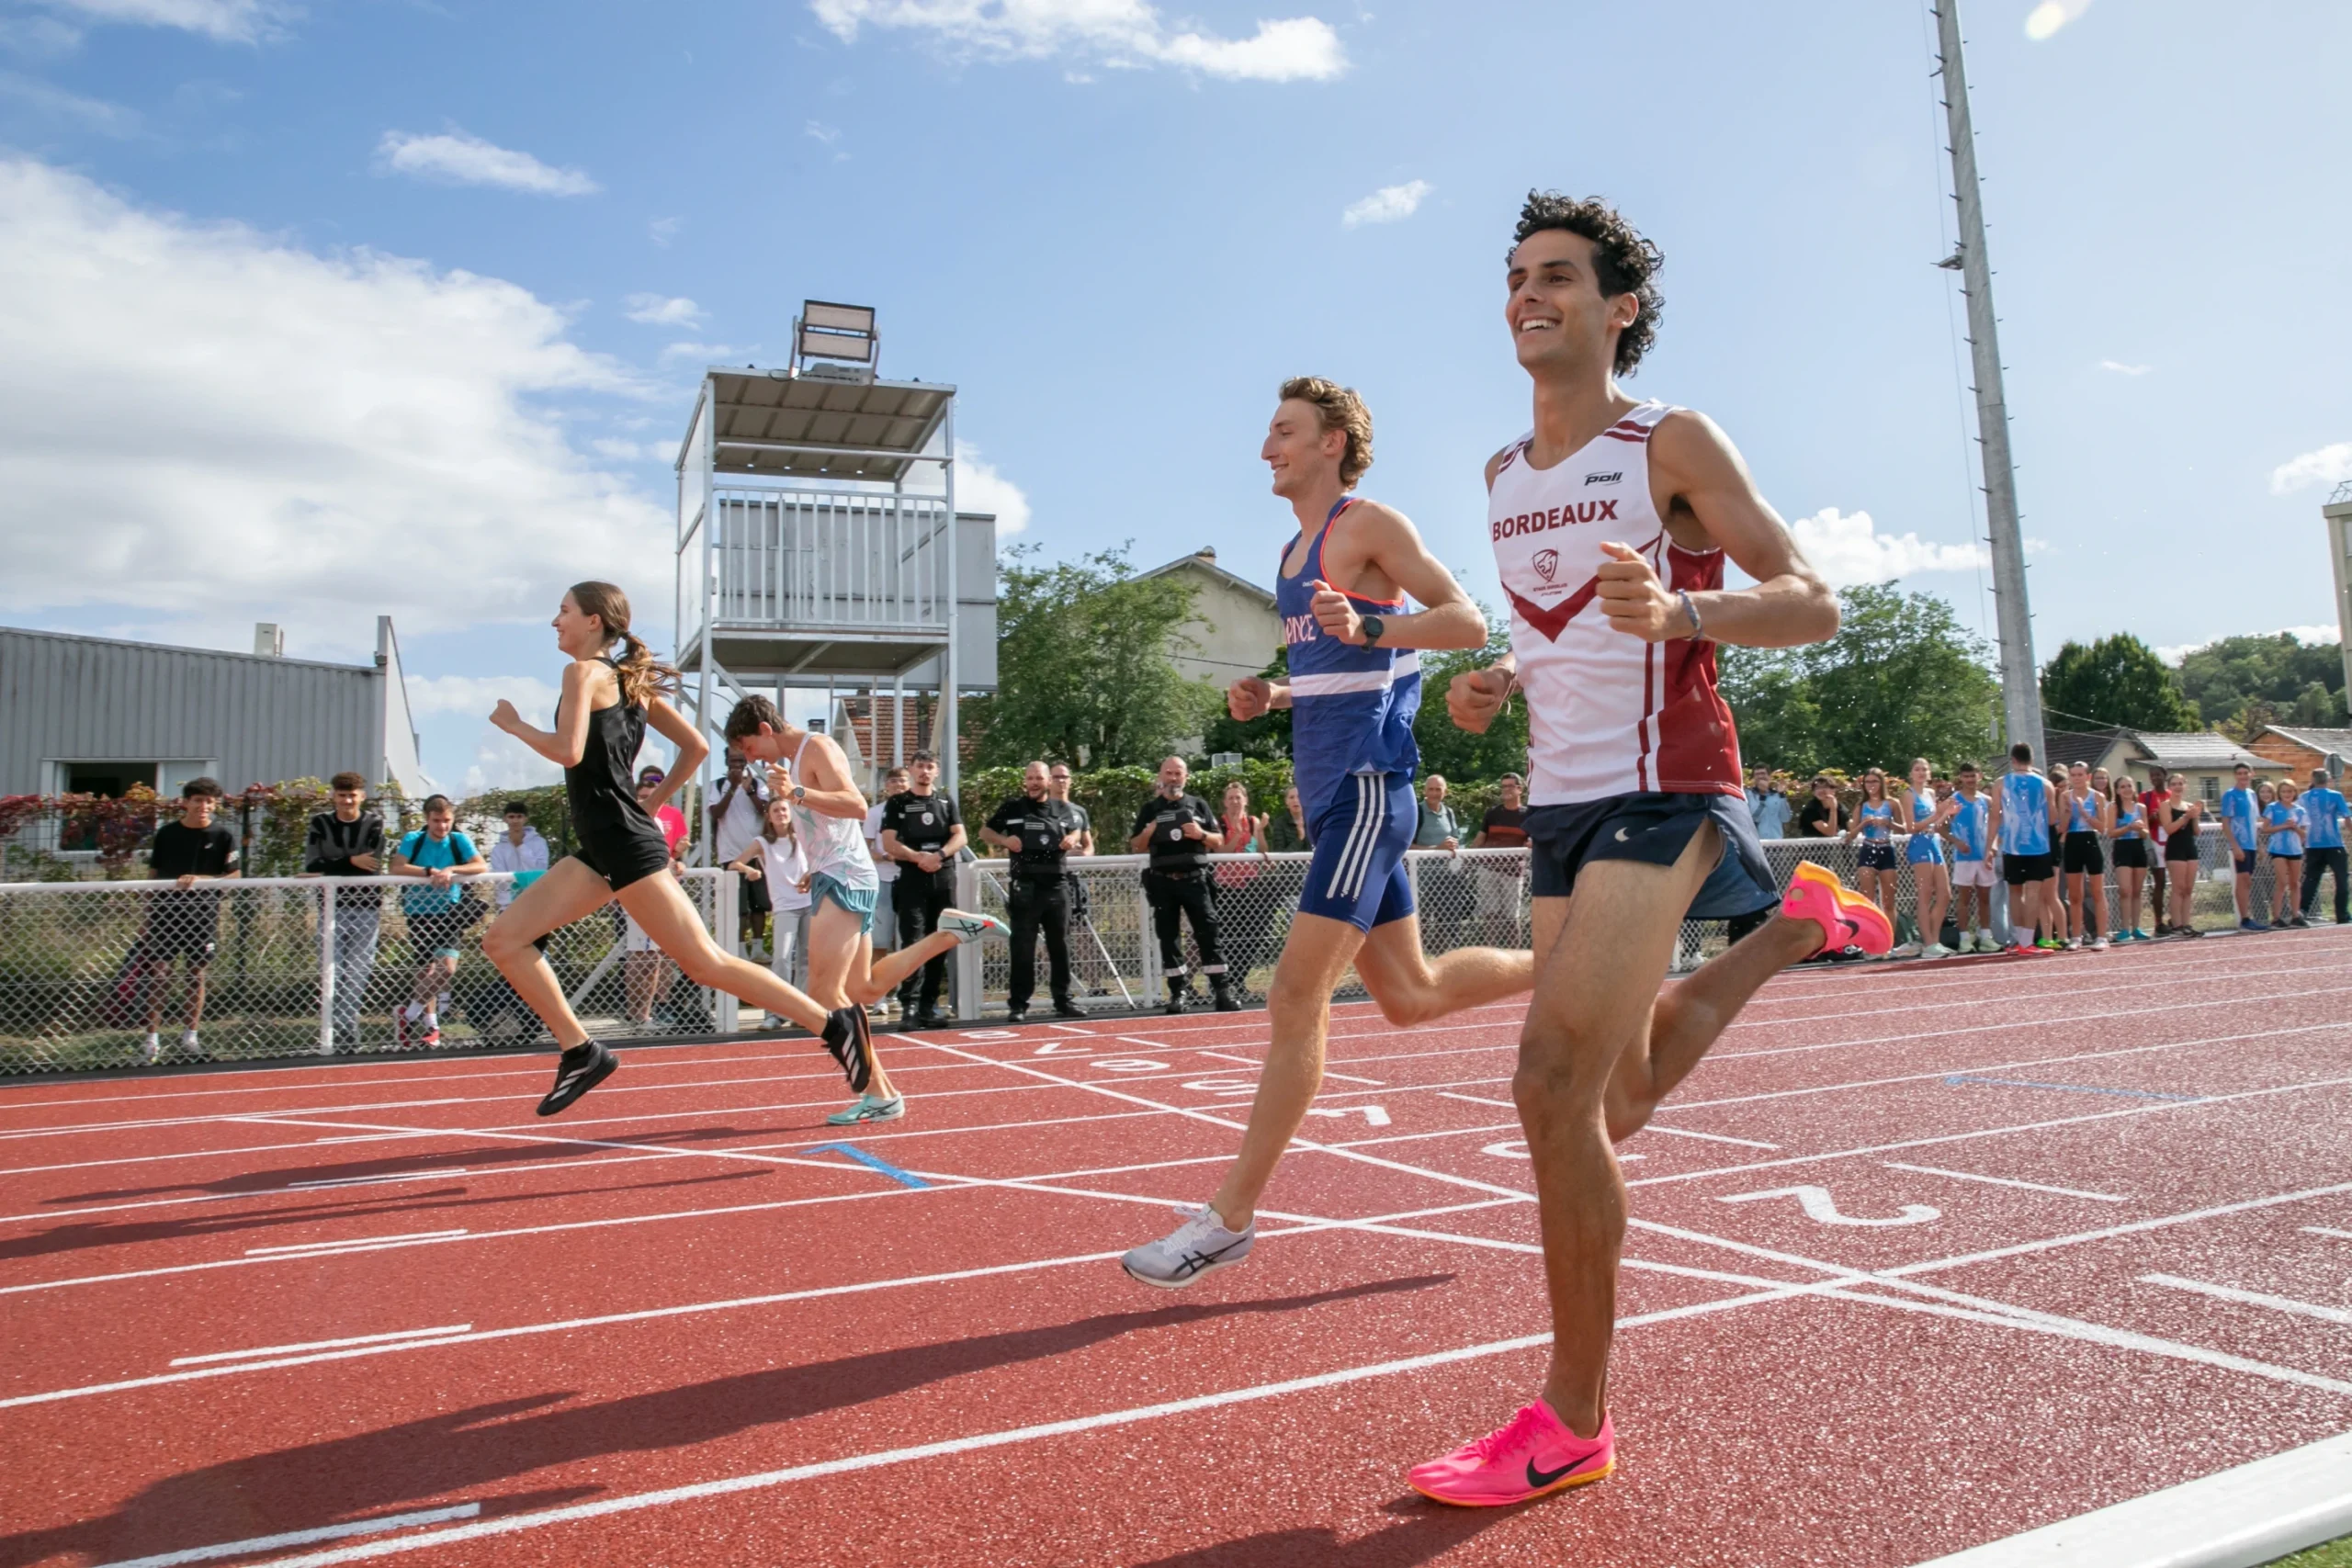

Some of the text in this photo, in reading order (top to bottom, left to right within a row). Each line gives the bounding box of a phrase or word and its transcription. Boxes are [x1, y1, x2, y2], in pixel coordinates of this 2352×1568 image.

[1492, 499, 1619, 543] BORDEAUX
[1286, 614, 1317, 645] ANCE
[1713, 1183, 1941, 1227] 2
